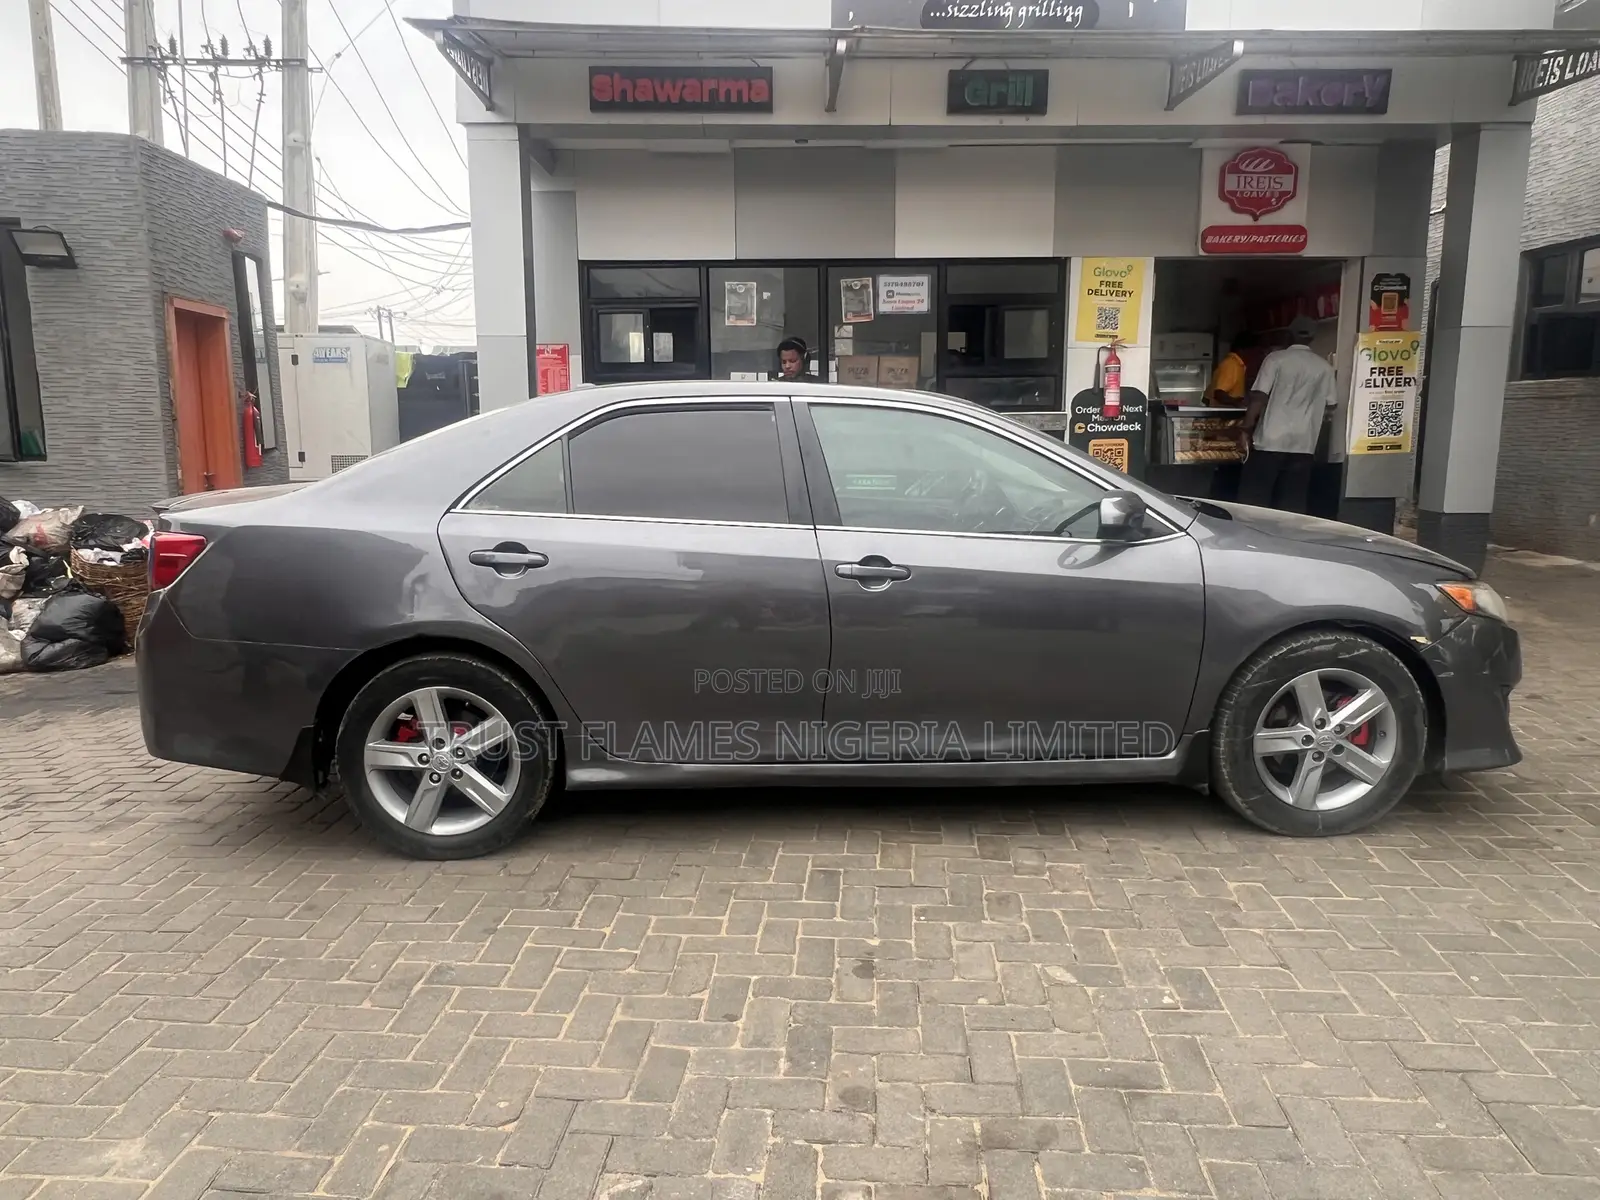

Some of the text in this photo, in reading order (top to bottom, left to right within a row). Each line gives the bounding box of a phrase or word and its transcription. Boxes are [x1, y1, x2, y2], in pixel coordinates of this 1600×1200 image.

[1018, 0, 1084, 29] grilling
[1564, 51, 1600, 80] LOA
[591, 72, 769, 104] Shawarma
[965, 74, 1034, 106] Grill
[1236, 175, 1284, 190] IREIS
[1093, 265, 1129, 278] Glovo
[1099, 280, 1124, 289] FREE
[1087, 289, 1134, 298] DELIVERY
[1360, 347, 1411, 361] Glovo
[1369, 366, 1403, 377] FREE
[1075, 405, 1142, 414] Order Next
[1087, 422, 1142, 432] Chowdeck
